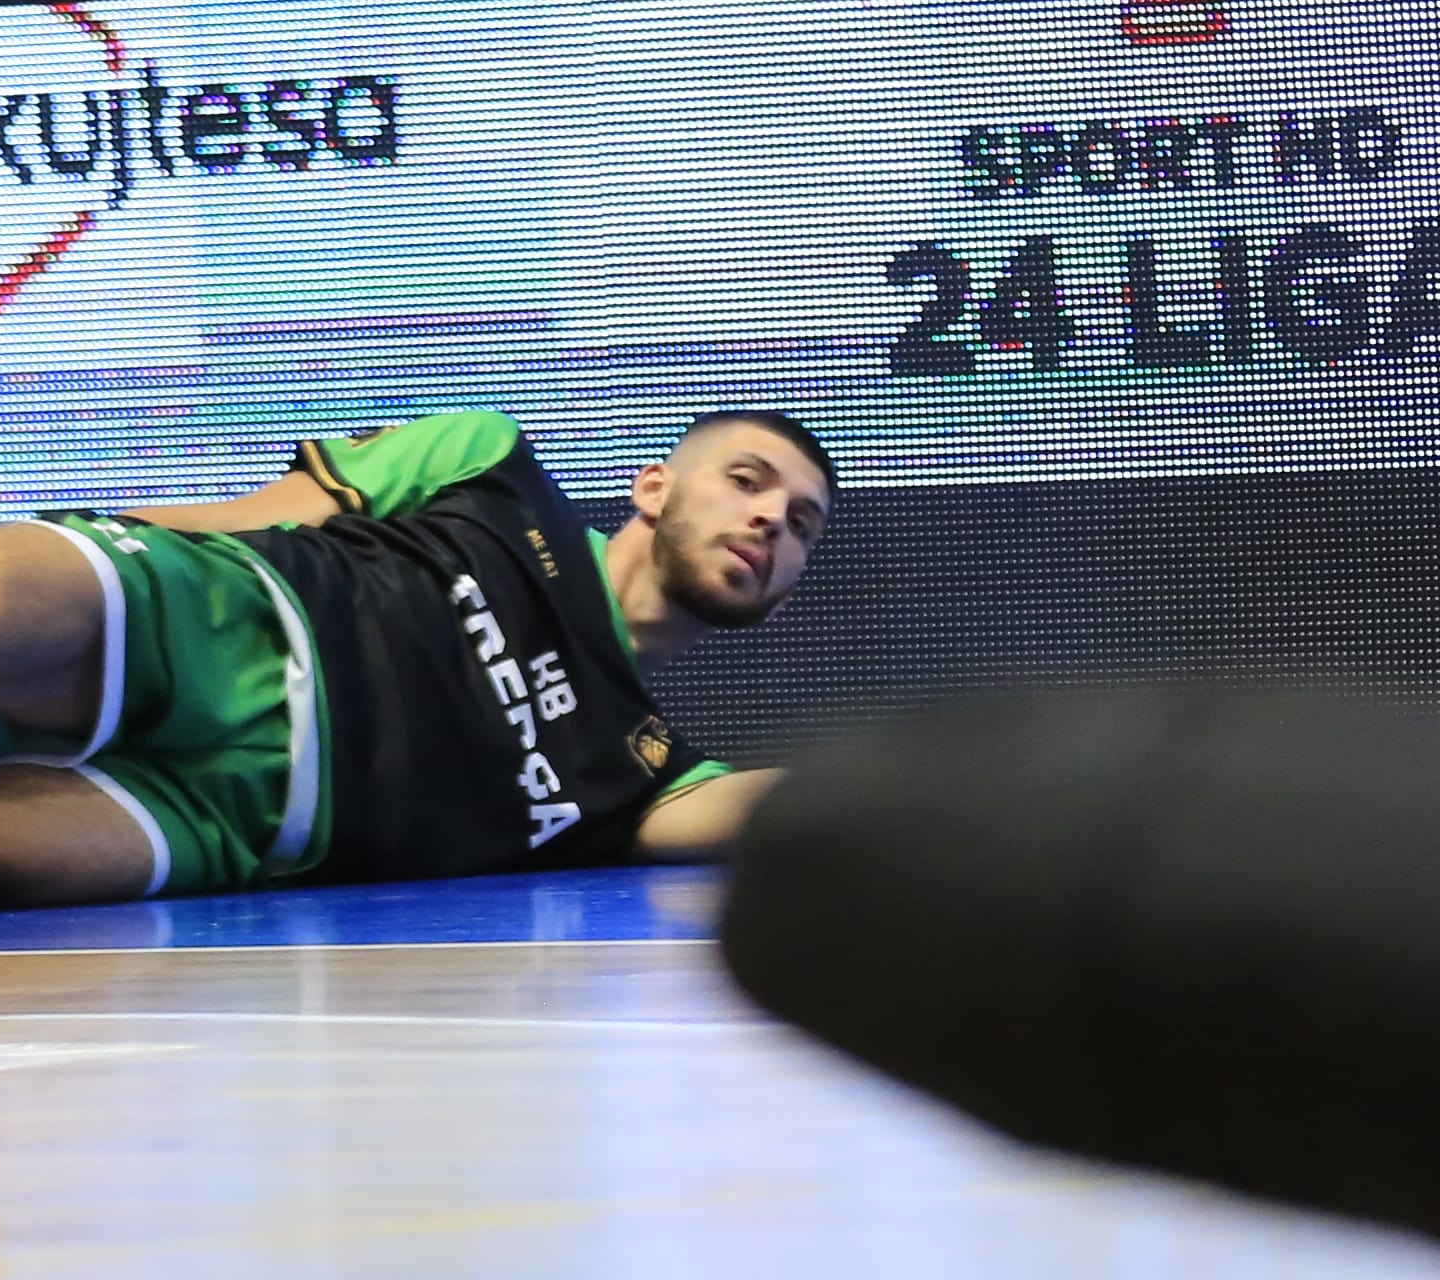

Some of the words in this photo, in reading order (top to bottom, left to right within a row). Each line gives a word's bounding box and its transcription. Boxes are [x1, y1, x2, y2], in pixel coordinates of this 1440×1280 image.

[960, 113, 1246, 200] SPORT
[1274, 104, 1402, 186] HD
[882, 236, 1072, 380] 24
[525, 650, 579, 722] KB
